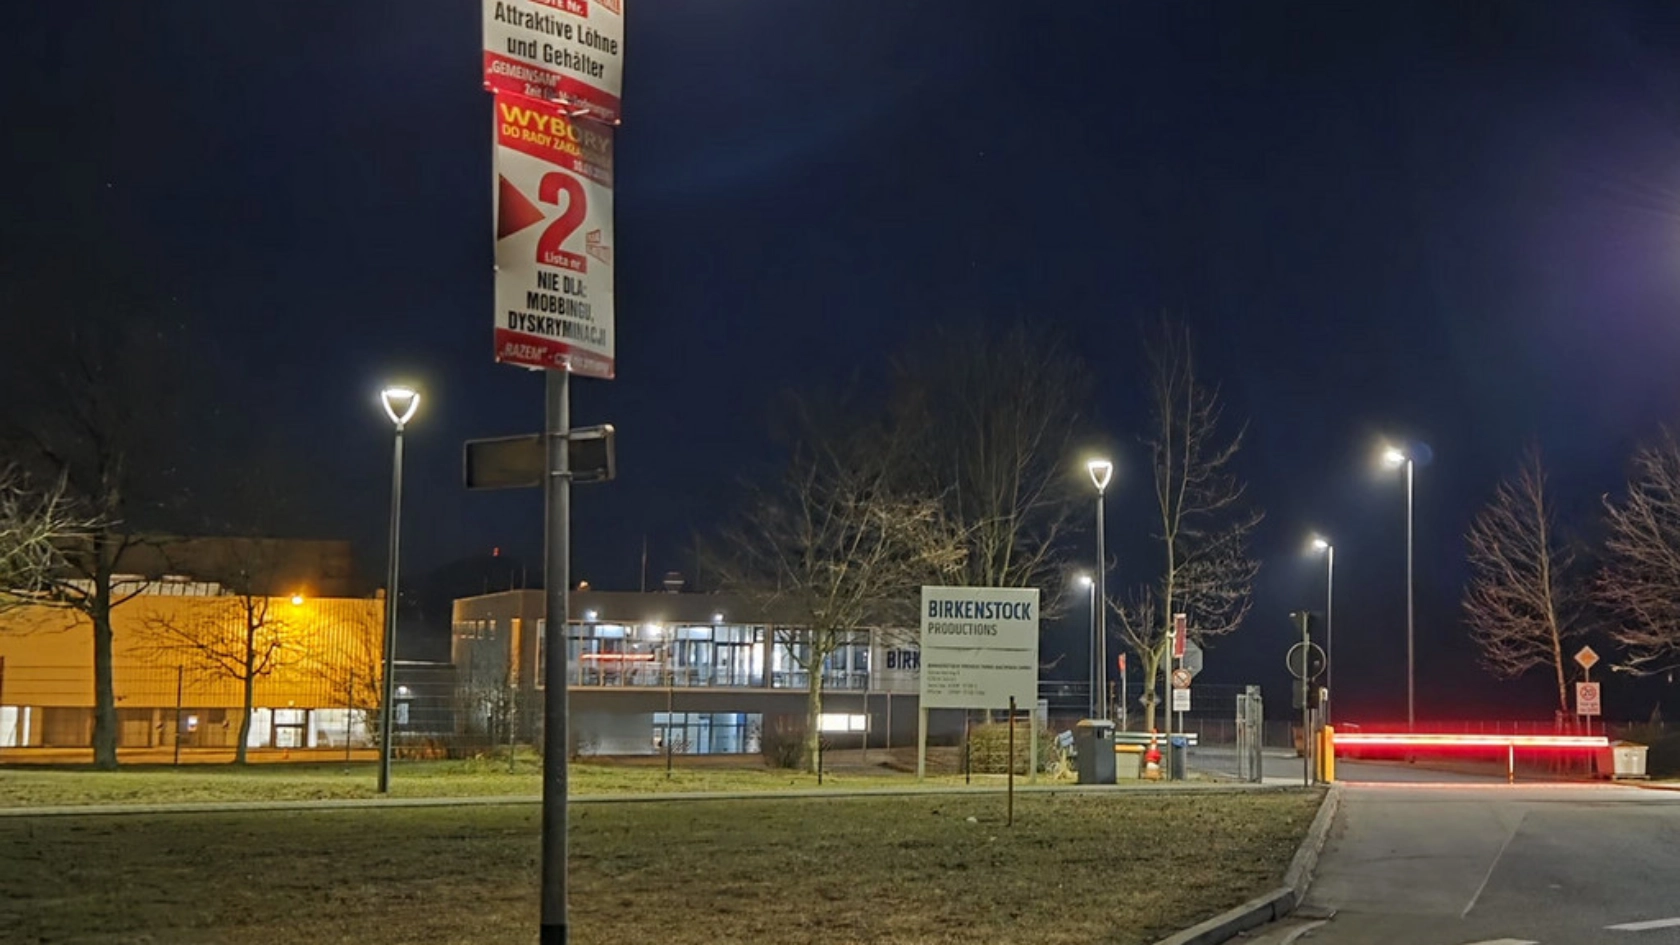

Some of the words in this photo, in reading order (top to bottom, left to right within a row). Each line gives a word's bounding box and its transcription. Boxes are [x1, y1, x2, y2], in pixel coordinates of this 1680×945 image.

[494, 1, 573, 40] Attraktive
[577, 24, 618, 55] Löhne
[507, 37, 537, 59] und
[543, 43, 604, 79] Gehälter
[500, 103, 609, 153] WYBORY
[502, 123, 520, 138] DO
[523, 128, 551, 147] RADY
[536, 171, 587, 274] 2
[545, 250, 568, 267] Lista
[537, 271, 559, 291] NIE
[508, 311, 606, 347] DYSKRYMINACJI
[928, 600, 1031, 620] BIRKENSTOCK
[928, 622, 998, 636] PRODUCTIONS
